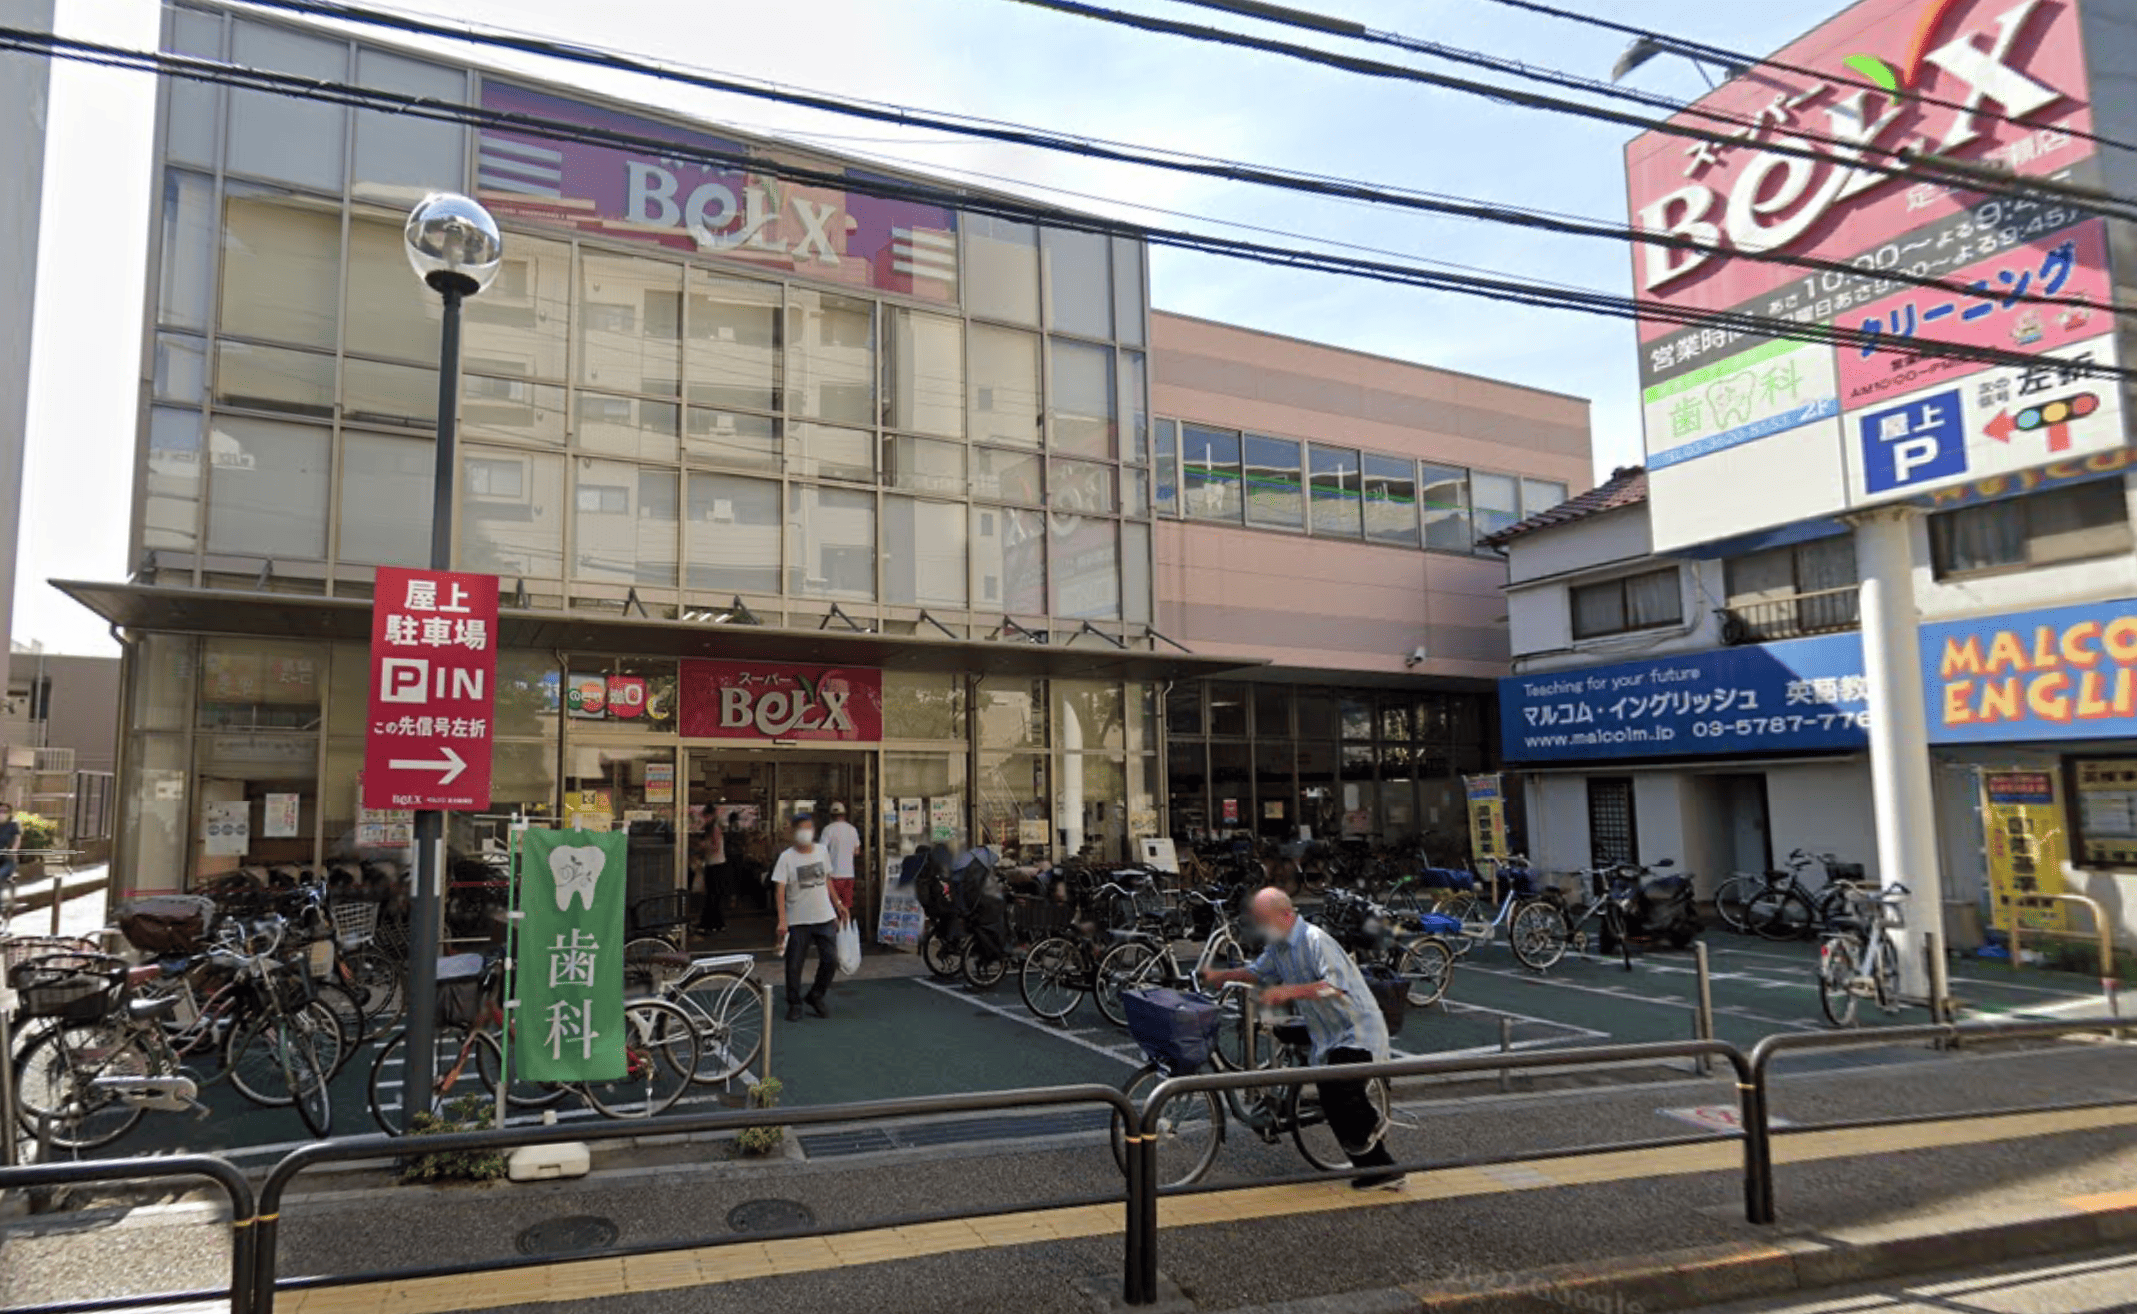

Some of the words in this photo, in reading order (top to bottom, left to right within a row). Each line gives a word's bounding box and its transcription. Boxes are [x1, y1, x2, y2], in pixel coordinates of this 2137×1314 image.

[1858, 241, 2076, 359] クリーニング
[1893, 434, 1939, 482] P
[404, 579, 471, 613] 屋上
[384, 614, 488, 651] 駐車場
[386, 662, 426, 700] P
[436, 667, 485, 700] IN
[738, 671, 791, 685] スーパー
[1523, 680, 1584, 698] Teaching
[1586, 675, 1608, 691] for
[1611, 673, 1645, 692] your
[1650, 666, 1701, 684] future
[1523, 686, 1759, 727] マルコム・イングリッシュ
[373, 715, 487, 738] この先信号左折
[1524, 724, 1676, 748] www.malcolm.jp
[543, 927, 600, 1061] 歯科
